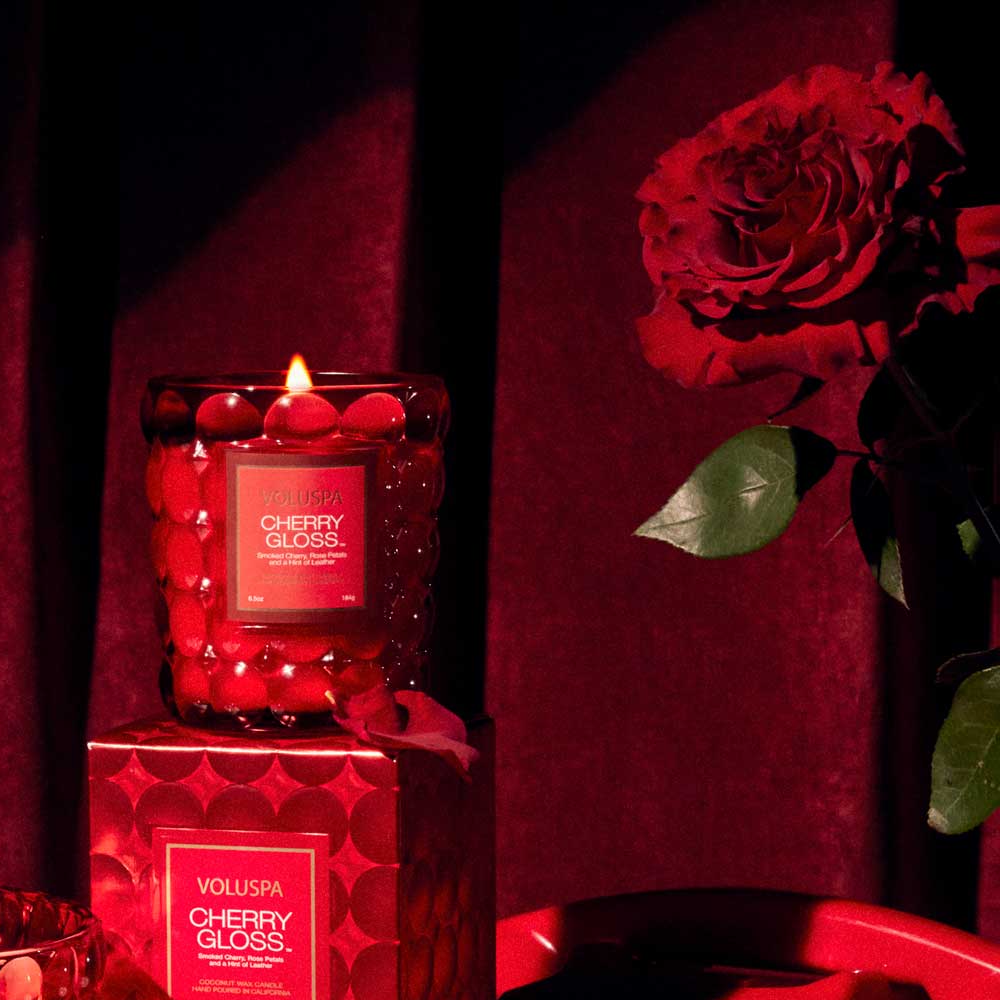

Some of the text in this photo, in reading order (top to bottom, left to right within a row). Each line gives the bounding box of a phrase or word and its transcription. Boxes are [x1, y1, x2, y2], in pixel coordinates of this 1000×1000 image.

[262, 489, 343, 506] VOLUSPA
[260, 514, 344, 531] CHERRY
[197, 877, 284, 897] VOLUSPA
[189, 907, 293, 930] CHERRY
[197, 952, 223, 960] Smoked
[224, 953, 246, 962] Cherry,
[250, 988, 291, 996] CALIFORNIA
